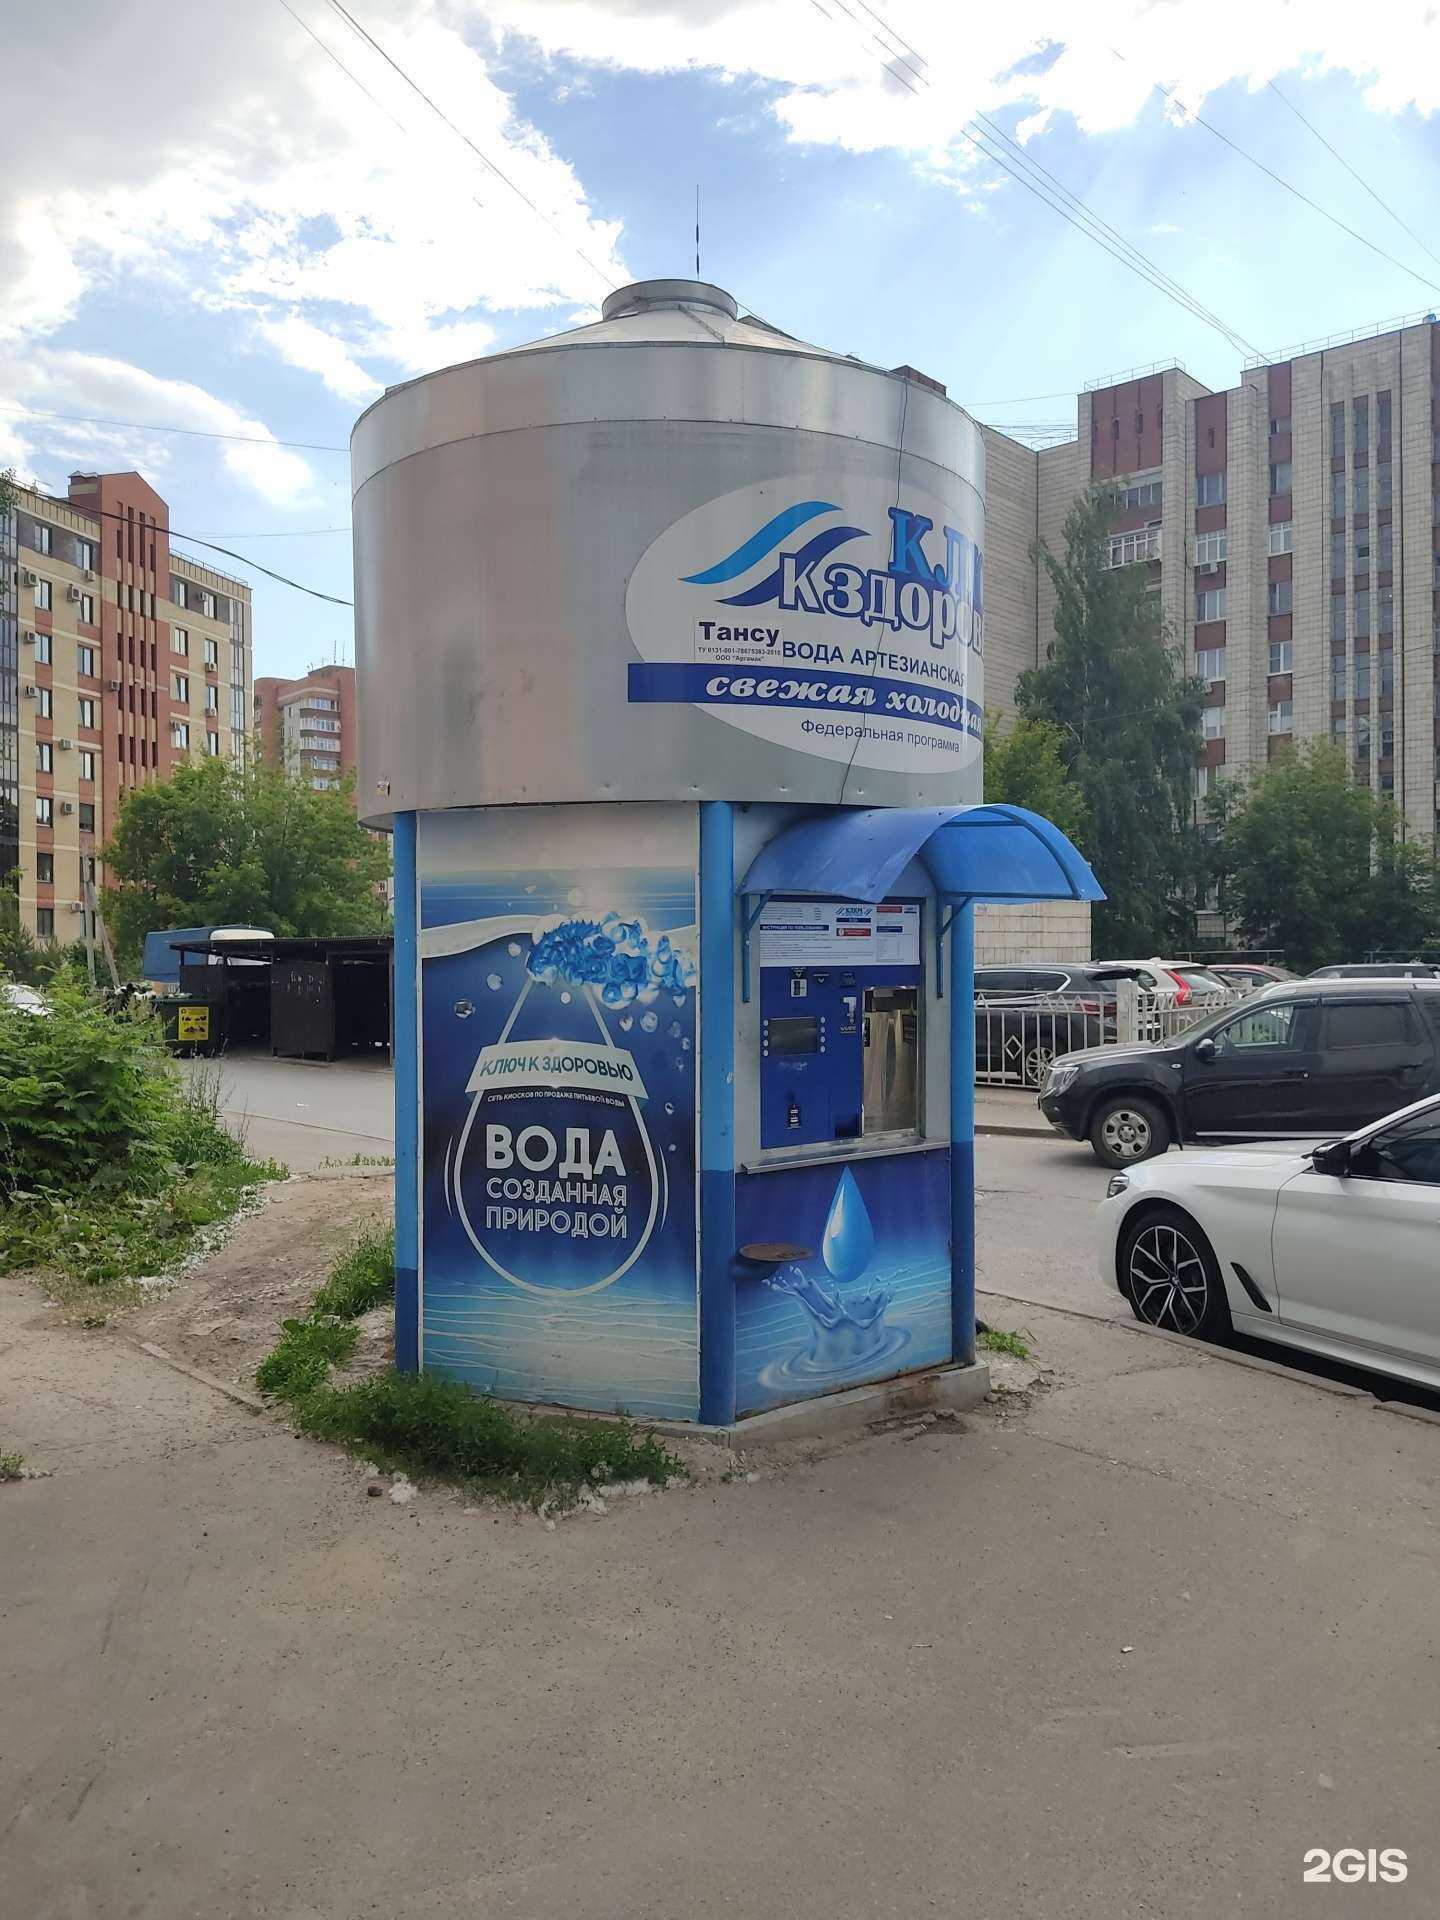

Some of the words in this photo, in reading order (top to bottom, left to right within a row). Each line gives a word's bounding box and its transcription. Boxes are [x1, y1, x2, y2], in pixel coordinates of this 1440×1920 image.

[699, 622, 780, 647] Тансу
[782, 641, 844, 664] ВОДА
[850, 648, 967, 688] АРТЕЗИАНСКАЯ
[706, 676, 877, 707] свежая
[801, 719, 904, 742] Федеральная
[907, 732, 960, 752] программа
[480, 1057, 527, 1077] КЛЮЧ
[529, 1056, 541, 1072] К
[542, 1056, 634, 1081] ЗДОРОВЬЮ
[487, 1094, 503, 1102] СЕТЬ
[503, 1091, 534, 1100] КИОСКОВ
[544, 1091, 573, 1099] ПРОДАЖЕ
[574, 1092, 605, 1103] ПИТЬЕВОЙ
[605, 1097, 625, 1107] ВОДЫ
[486, 1124, 627, 1180] ВОДА
[486, 1177, 627, 1207] СОЗДАННАЯ
[486, 1206, 627, 1239] ПРИРОДОЙ
